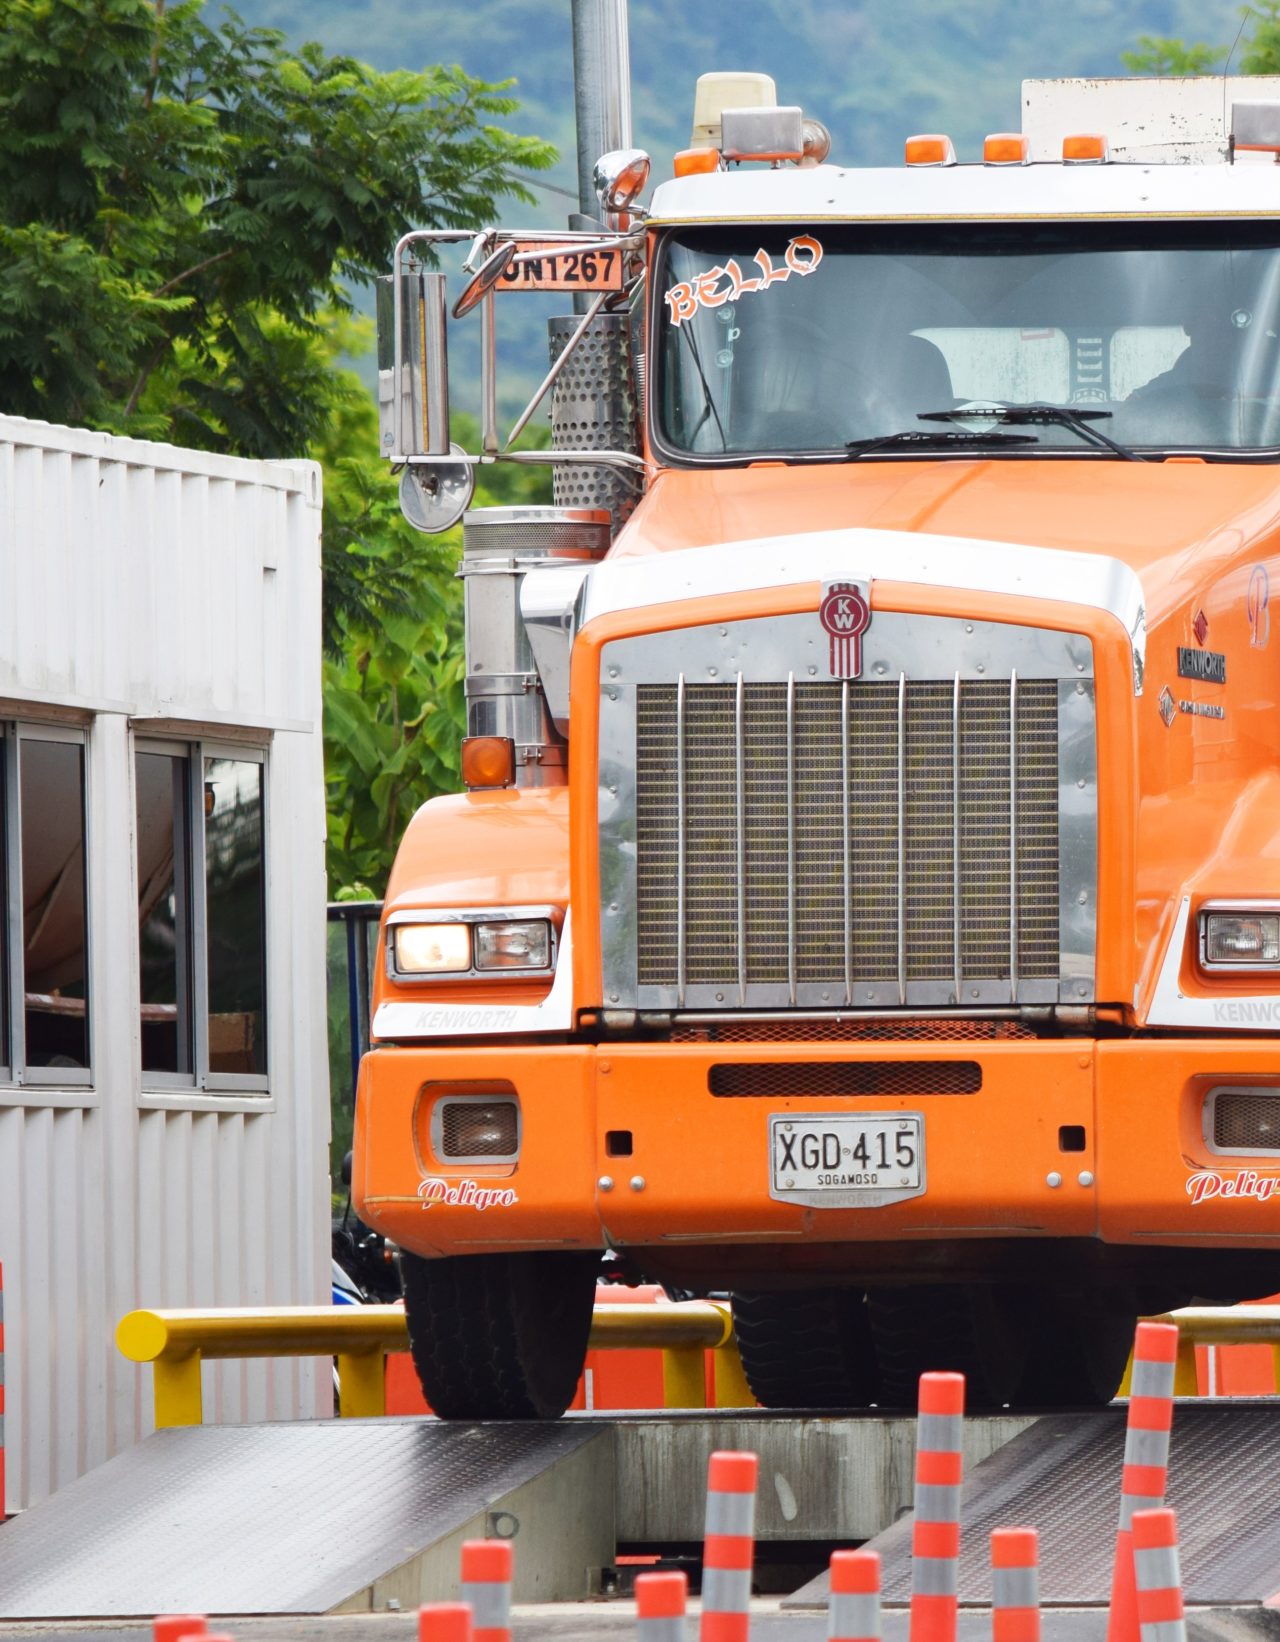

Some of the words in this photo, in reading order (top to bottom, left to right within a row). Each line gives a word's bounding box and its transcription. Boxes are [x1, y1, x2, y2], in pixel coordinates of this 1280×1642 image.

[665, 234, 823, 327] BELLO
[1179, 648, 1225, 676] KENWORTH
[415, 1010, 518, 1028] KENWORTH
[817, 1173, 878, 1185] SOGAMOSO
[417, 1178, 518, 1210] Peligro
